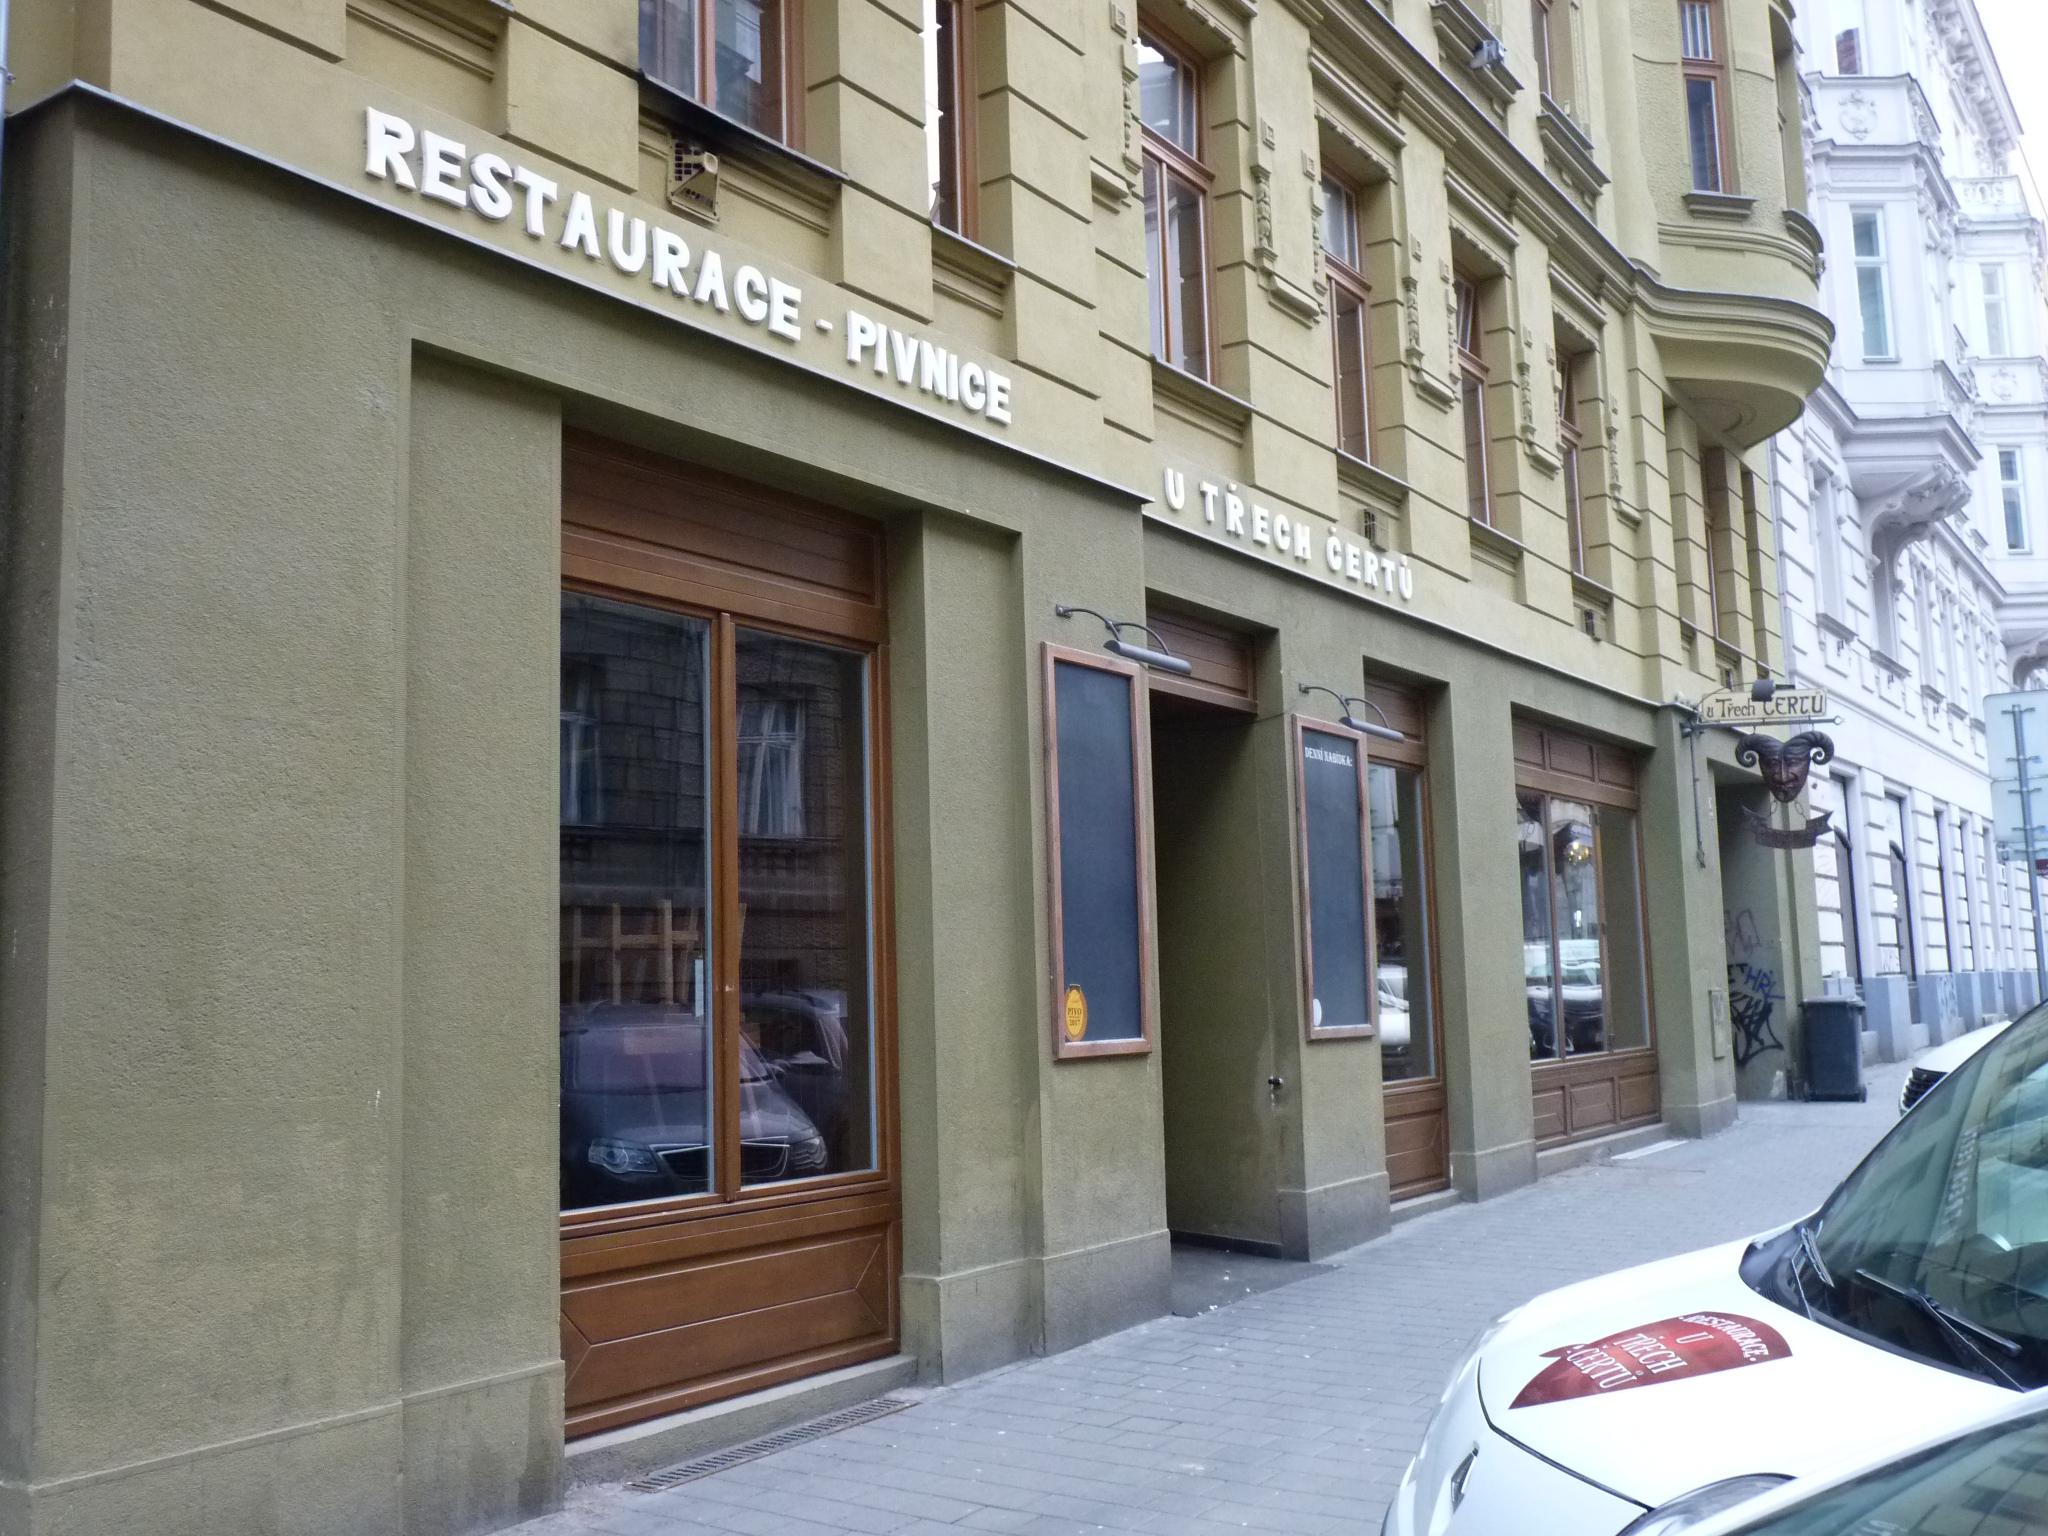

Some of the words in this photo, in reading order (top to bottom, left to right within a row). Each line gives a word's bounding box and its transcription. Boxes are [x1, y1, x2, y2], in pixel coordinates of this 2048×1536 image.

[365, 106, 802, 342] RESTAURACE
[845, 310, 1012, 425] PIVNICE
[1163, 466, 1185, 511] U
[1200, 480, 1312, 561] TŘECH
[1325, 526, 1413, 601] ČERTŮ
[1613, 1333, 1689, 1374] TŘECH
[1676, 1331, 1714, 1344] U
[1682, 1314, 1769, 1359] RESTAURACE
[1566, 1345, 1644, 1389] ČERTŮ
